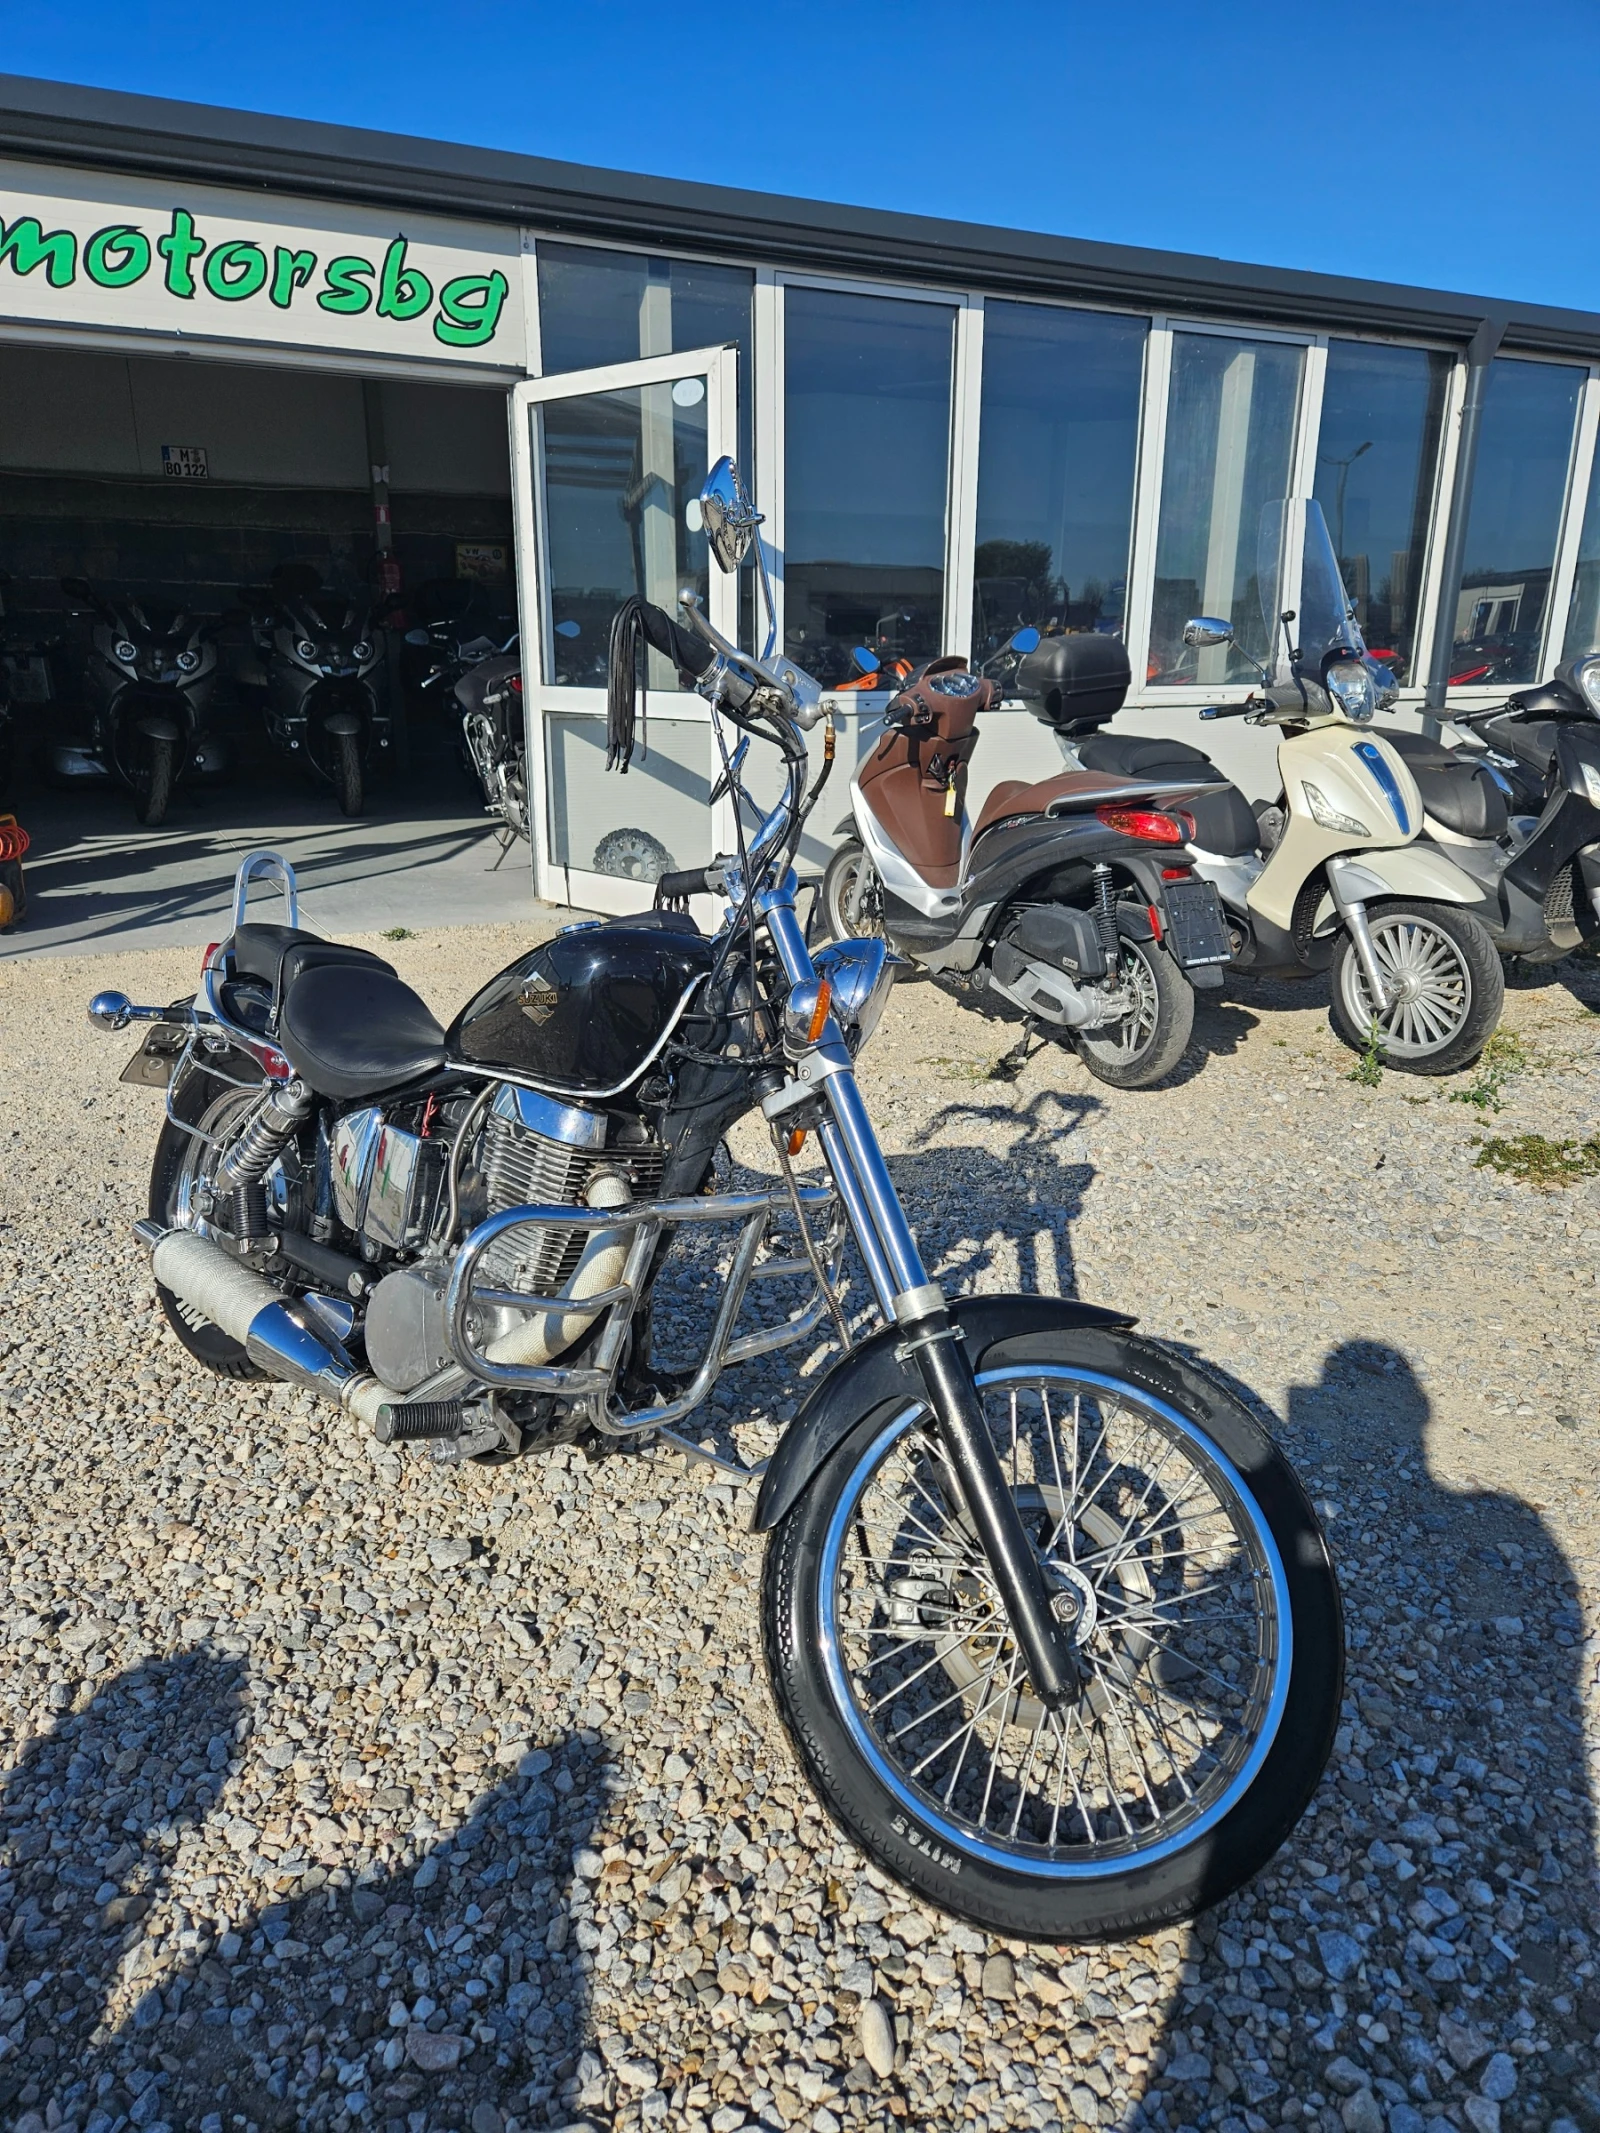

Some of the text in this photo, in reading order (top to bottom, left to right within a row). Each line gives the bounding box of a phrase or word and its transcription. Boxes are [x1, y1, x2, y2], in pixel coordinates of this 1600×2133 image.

[0, 207, 509, 348] motorsbg
[180, 448, 190, 462] M
[184, 463, 206, 478] 122
[517, 992, 558, 1006] SUZUKI
[890, 1814, 962, 1875] MITAS
